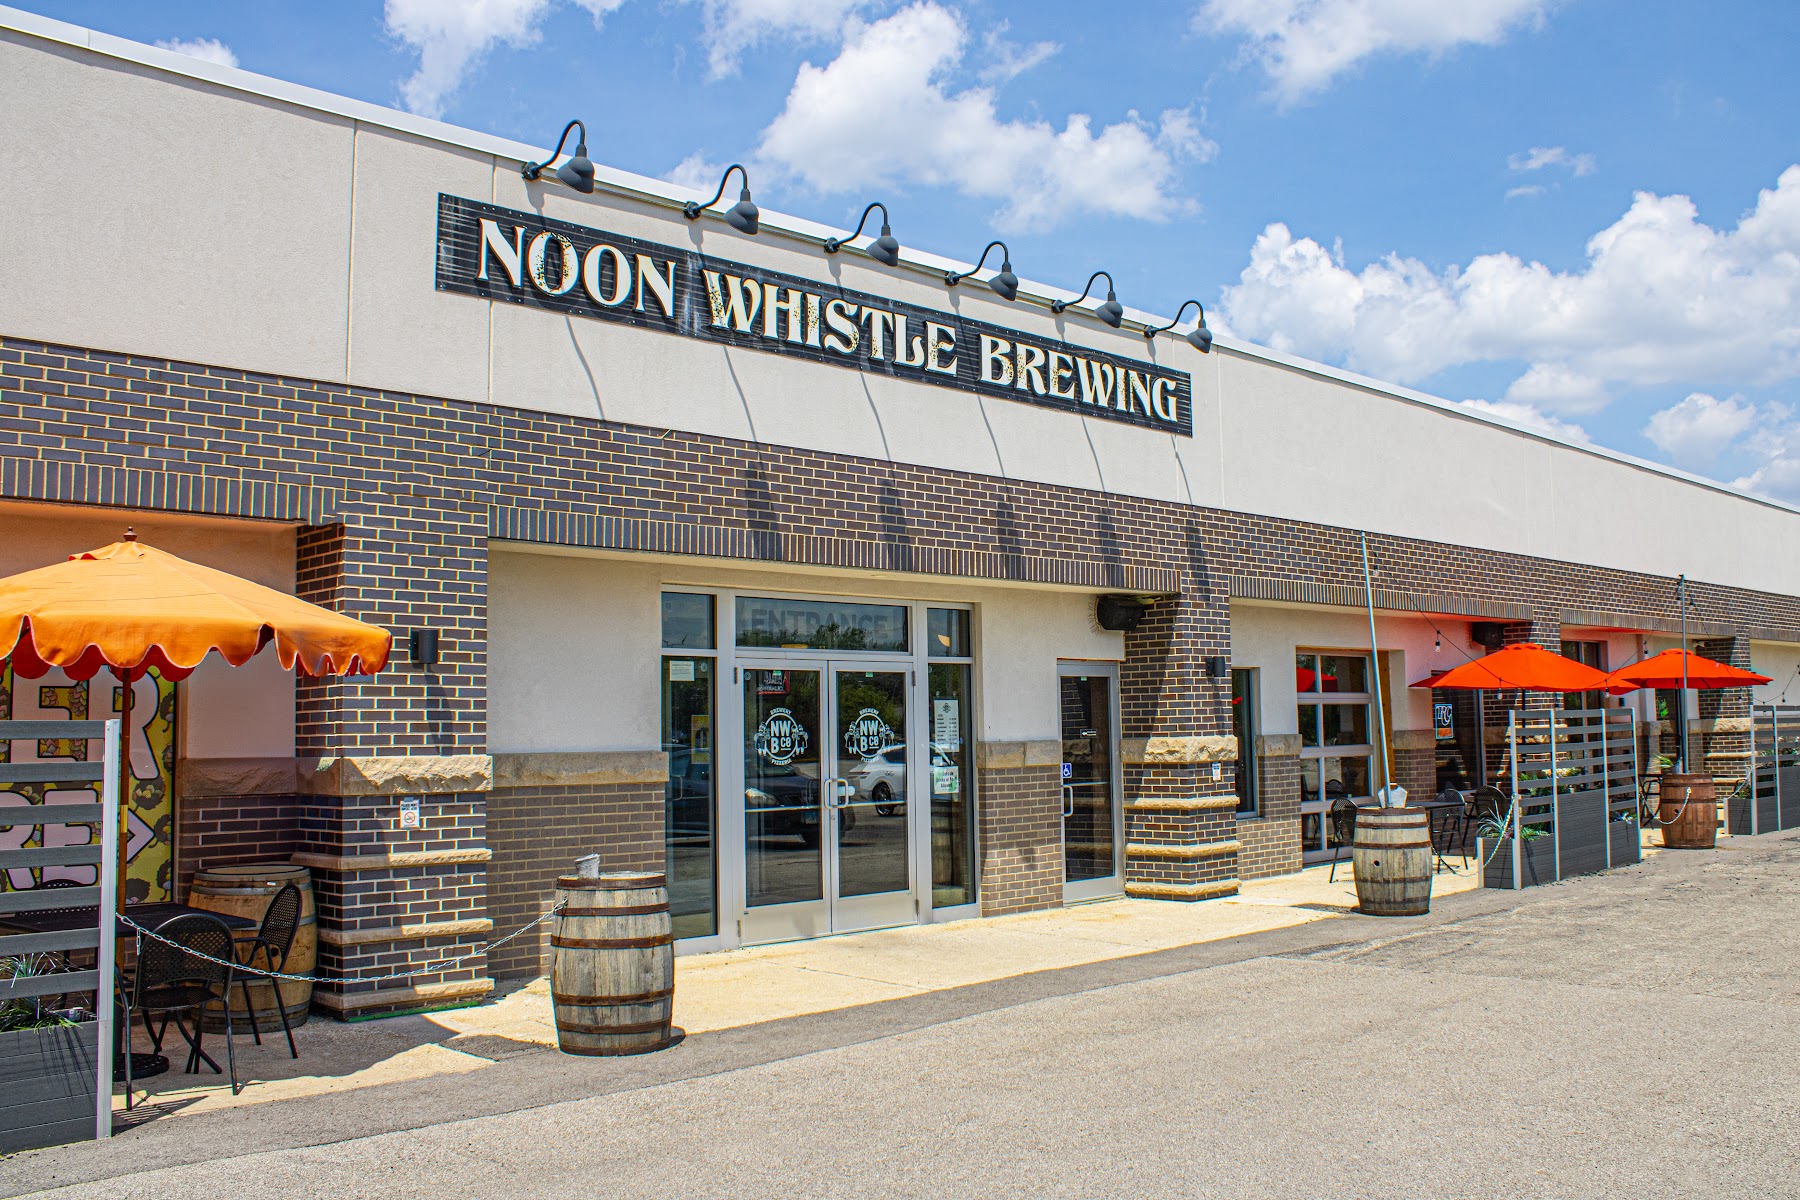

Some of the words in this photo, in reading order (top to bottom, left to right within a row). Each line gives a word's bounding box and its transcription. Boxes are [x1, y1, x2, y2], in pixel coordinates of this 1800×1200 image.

[476, 217, 677, 319] NOON
[702, 267, 958, 377] WHISTLE
[978, 333, 1179, 424] BREWING
[751, 608, 888, 639] ENTRANCE
[771, 720, 791, 737] NW
[860, 720, 878, 736] NW
